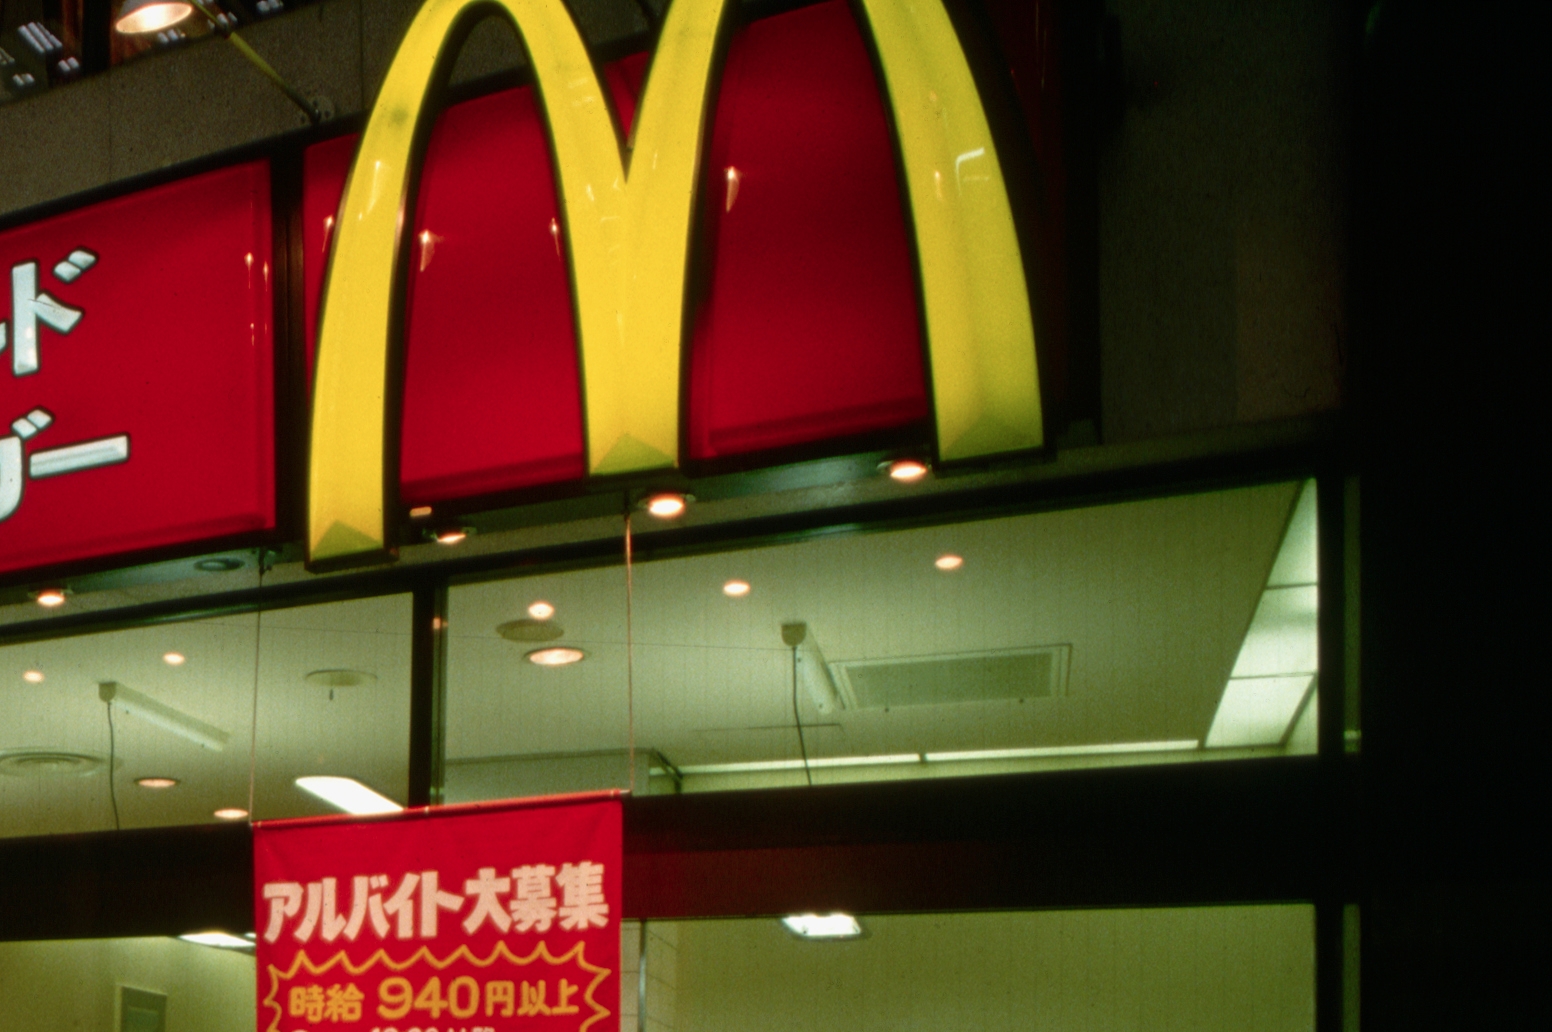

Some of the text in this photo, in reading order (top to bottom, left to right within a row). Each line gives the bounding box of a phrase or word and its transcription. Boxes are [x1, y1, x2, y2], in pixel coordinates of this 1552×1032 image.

[262, 860, 610, 944] アルバイト大募集
